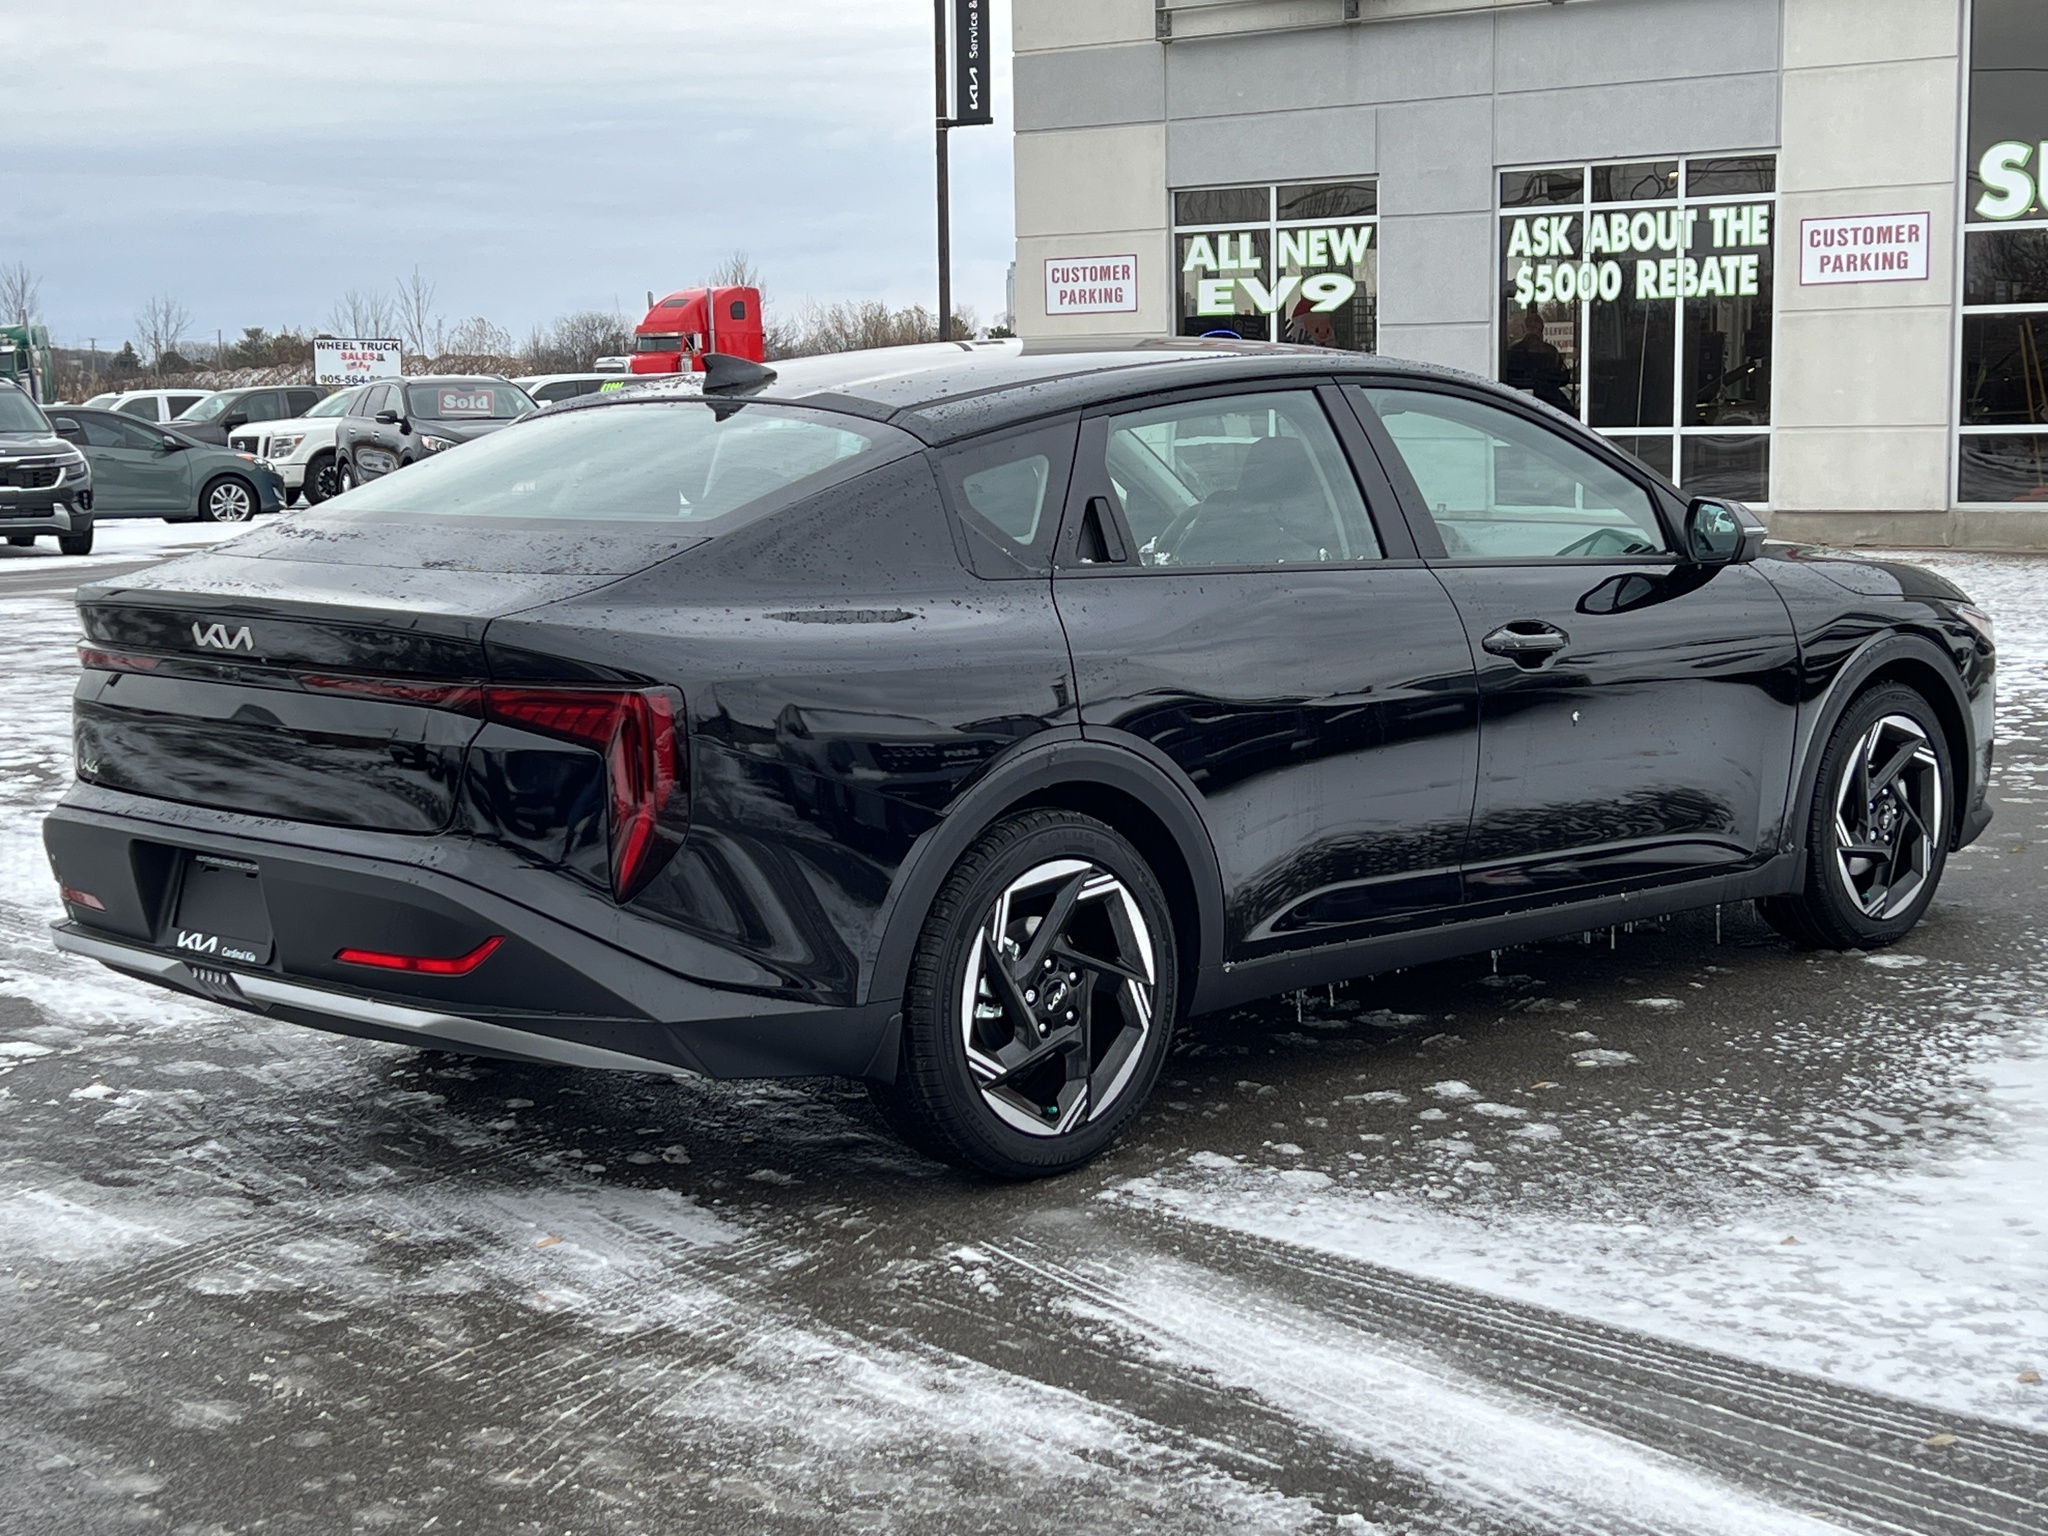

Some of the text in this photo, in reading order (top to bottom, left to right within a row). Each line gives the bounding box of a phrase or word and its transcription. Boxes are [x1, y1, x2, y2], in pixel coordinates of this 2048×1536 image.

[968, 12, 979, 59] Service
[1975, 140, 2048, 219] S
[1507, 204, 1770, 257] ASK ABOUT THE
[1809, 224, 1920, 248] CUSTOMER
[1182, 226, 1373, 272] ALL NEW
[1051, 264, 1131, 284] CUSTOMER
[1819, 251, 1909, 273] PARKING
[1514, 253, 1760, 309] $5000 REBATE
[1059, 287, 1124, 305] PARKING
[1197, 272, 1356, 316] EV9
[315, 342, 400, 351] WHEEL TRUCK
[340, 352, 376, 361] SALES
[443, 394, 489, 409] Sold
[191, 621, 254, 651] KIA
[177, 930, 218, 953] KIA
